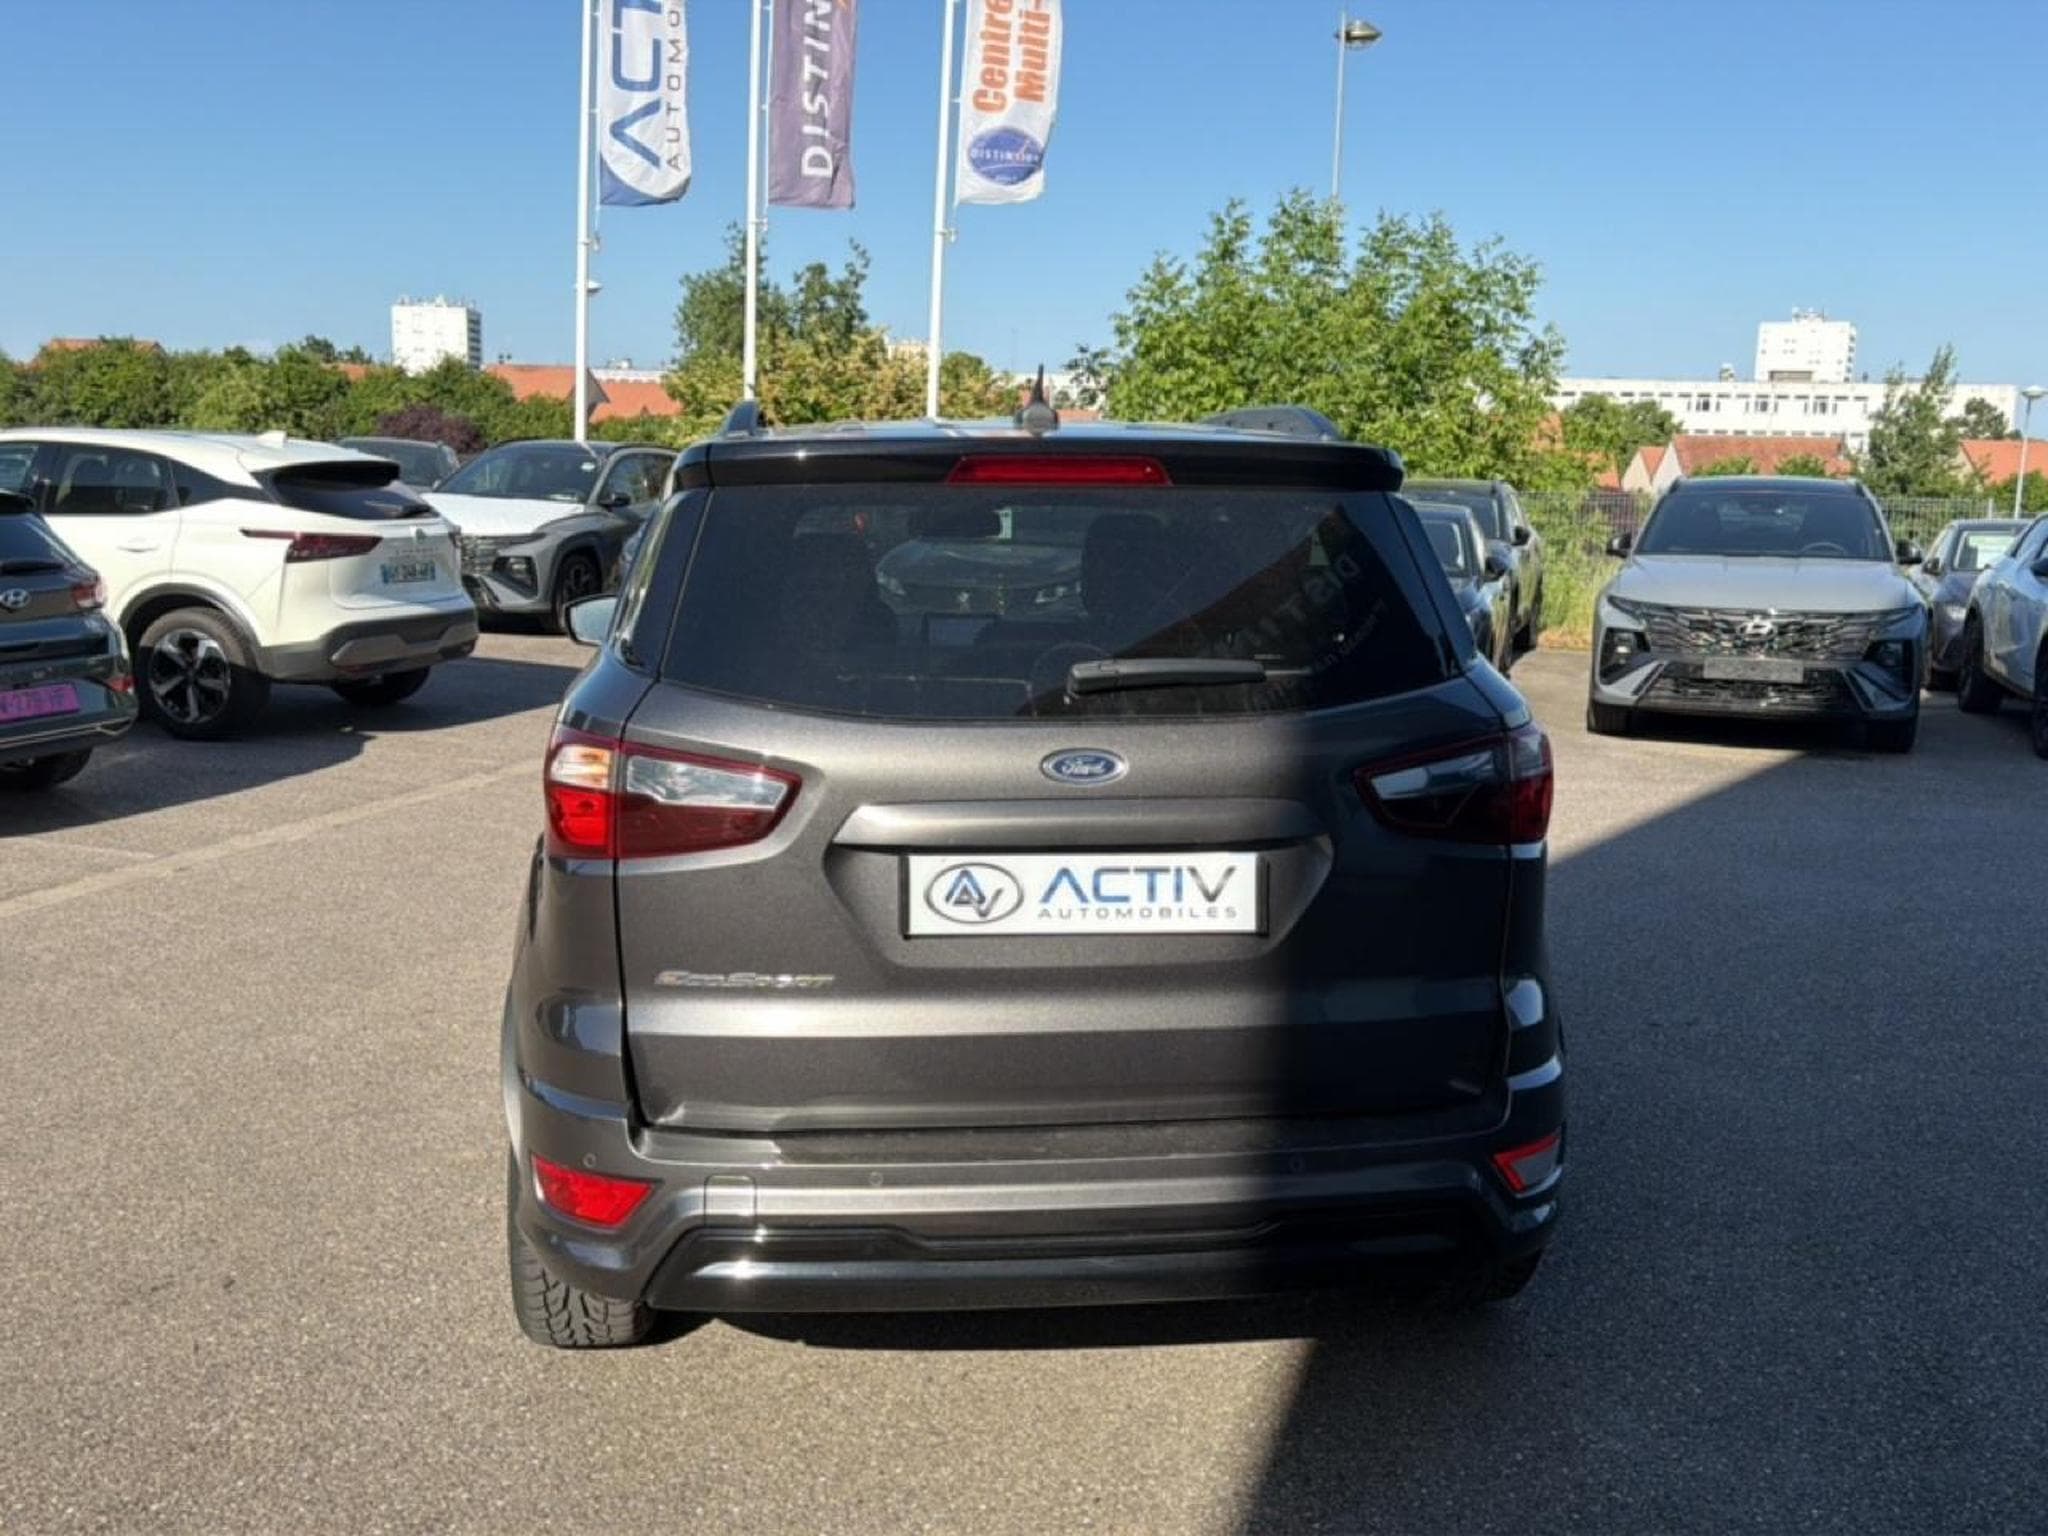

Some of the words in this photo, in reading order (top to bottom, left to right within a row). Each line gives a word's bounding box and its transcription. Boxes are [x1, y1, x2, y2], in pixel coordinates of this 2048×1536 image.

[972, 0, 1013, 113] Centre
[1039, 866, 1237, 904] ACTIV
[1038, 907, 1238, 920] AUTOMOBILES
